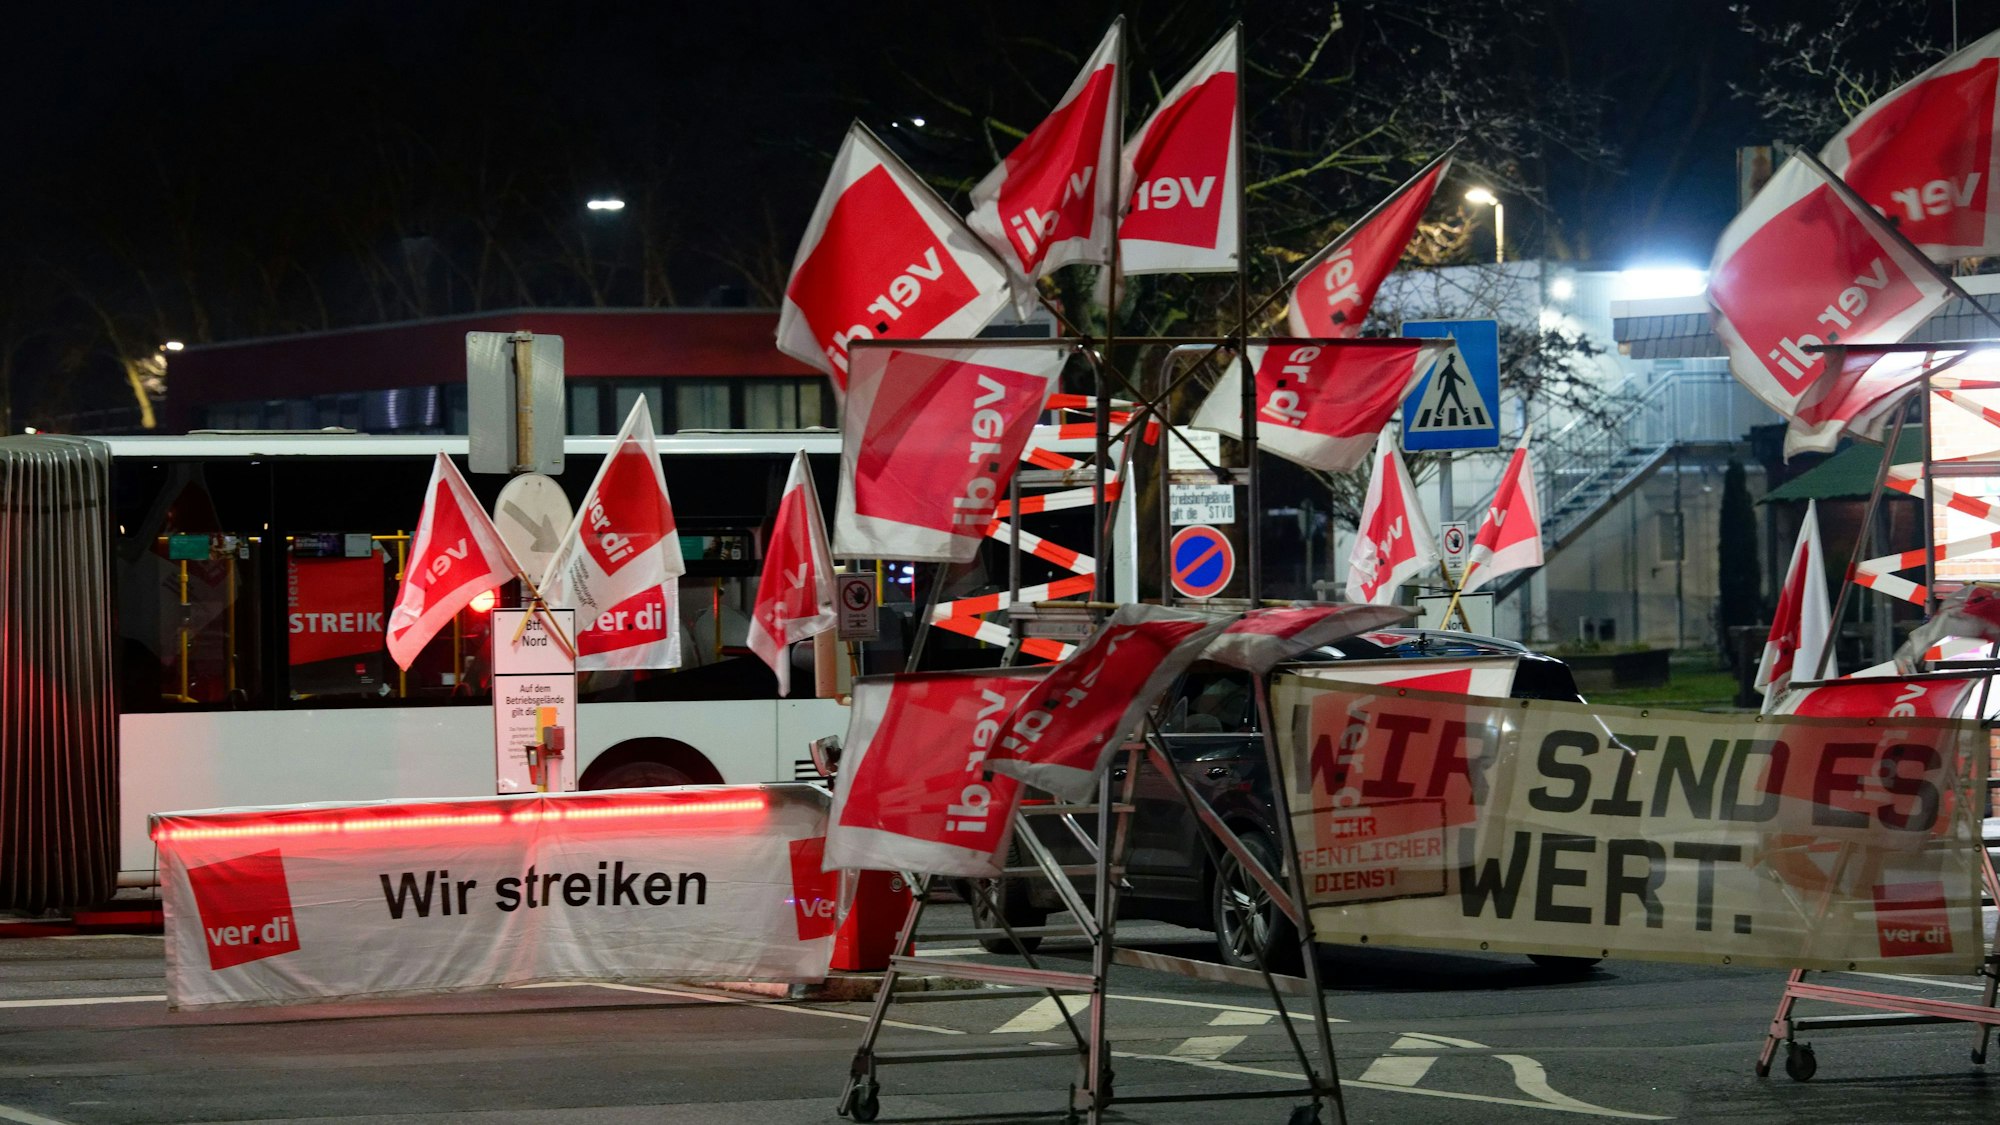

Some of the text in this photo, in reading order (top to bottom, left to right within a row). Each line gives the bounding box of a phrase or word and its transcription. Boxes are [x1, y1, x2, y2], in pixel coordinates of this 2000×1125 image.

[289, 612, 383, 634] STREIK
[526, 619, 543, 631] Btf.
[522, 634, 548, 647] Nord
[519, 684, 551, 693] Auf dem
[506, 696, 564, 706] Betriebsgelände
[511, 708, 524, 719] gilt
[1291, 703, 1943, 832] WIR SIND ES
[1334, 817, 1377, 839] IHR
[379, 860, 708, 920] Wir streiken
[1314, 867, 1399, 893] DIENST
[1457, 827, 1752, 935] WERT.
[206, 915, 291, 948] ver.di
[1883, 925, 1945, 944] ver.di
